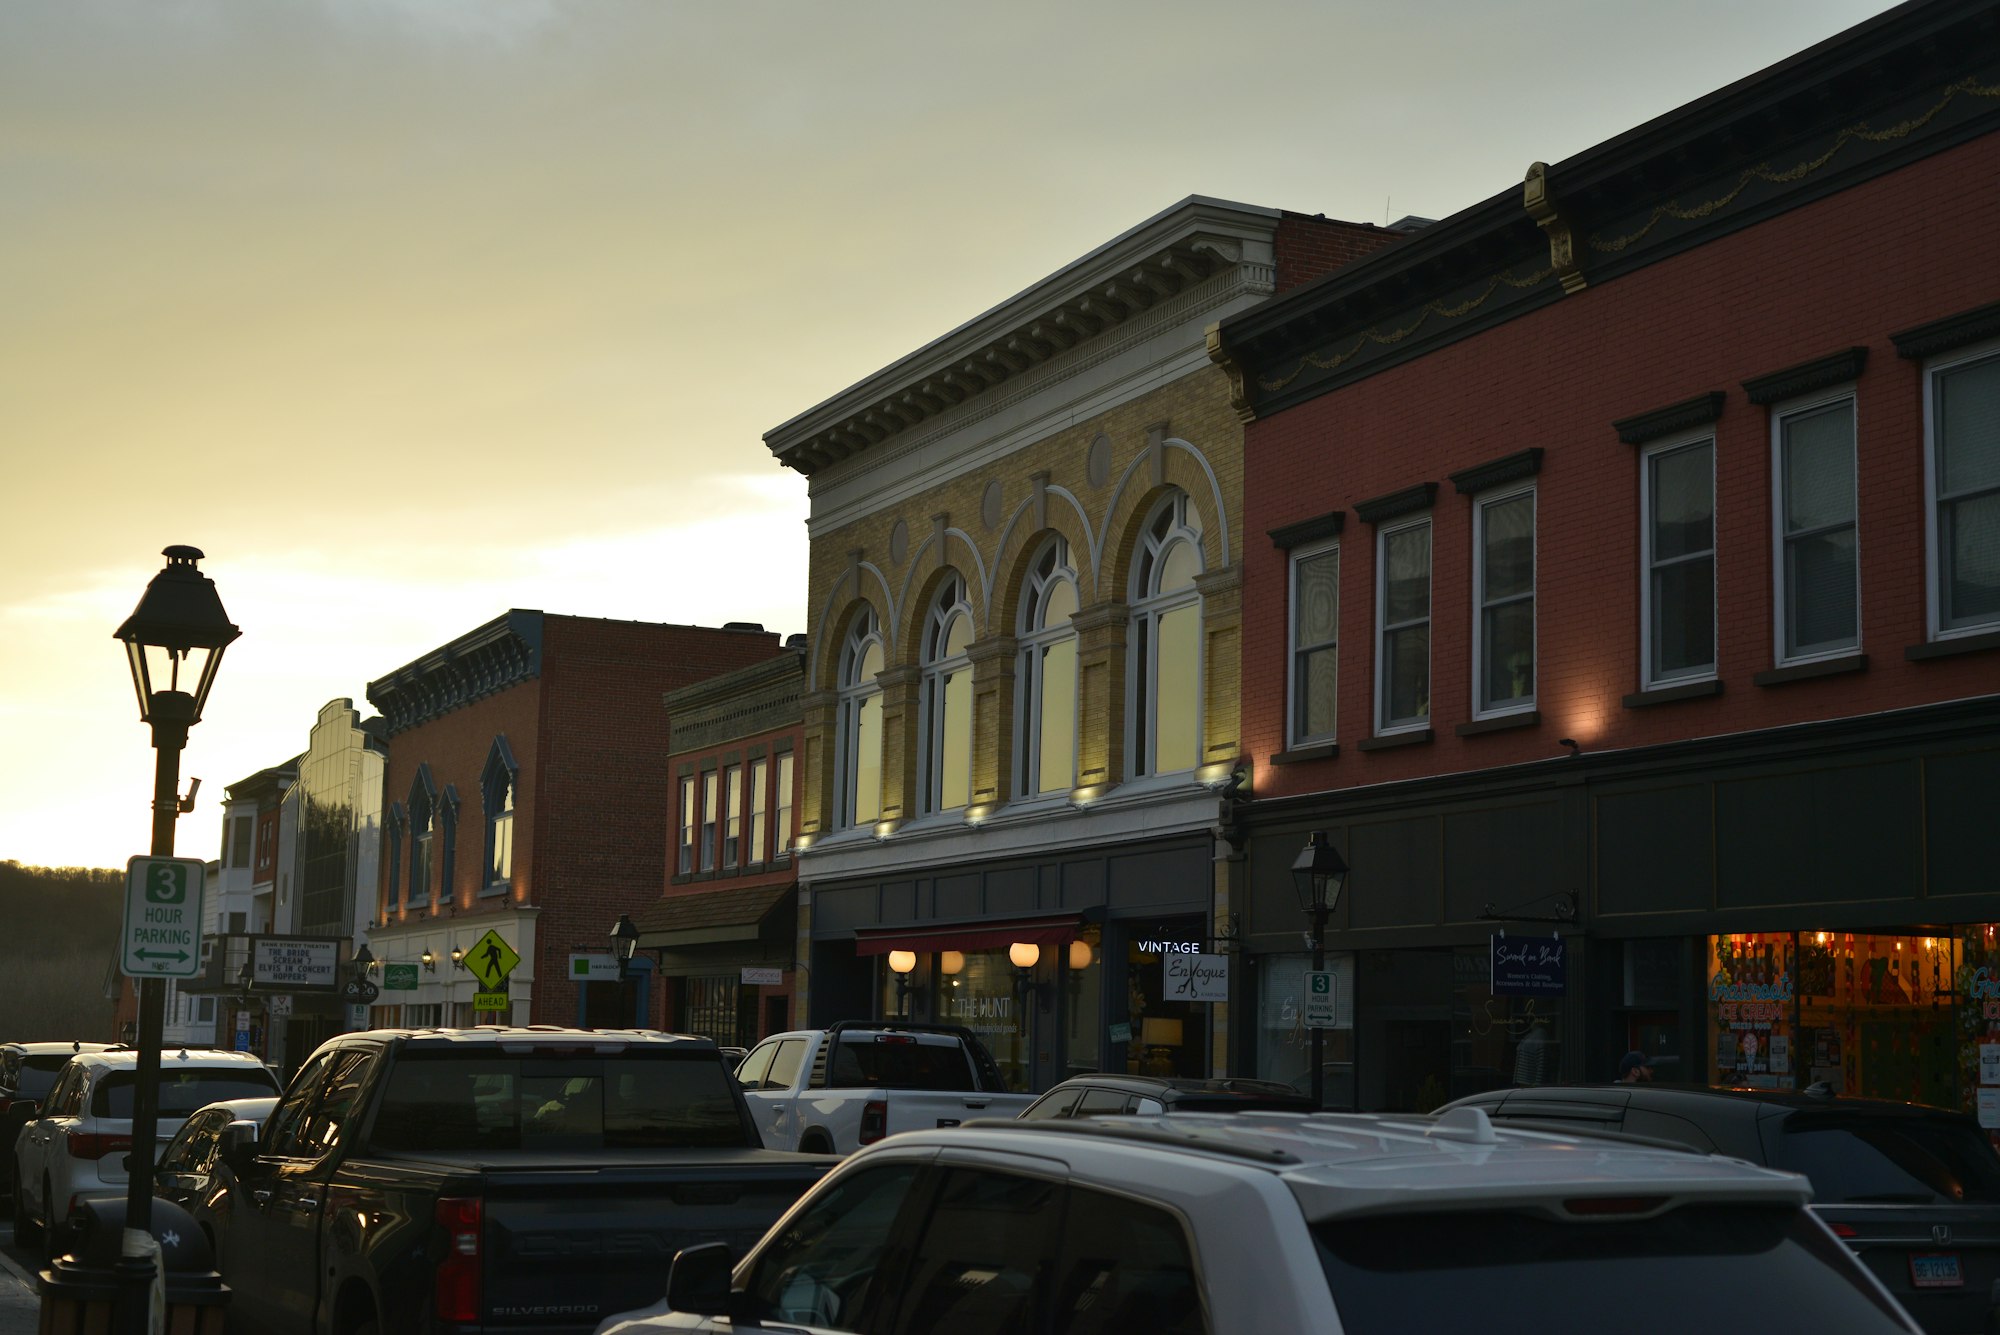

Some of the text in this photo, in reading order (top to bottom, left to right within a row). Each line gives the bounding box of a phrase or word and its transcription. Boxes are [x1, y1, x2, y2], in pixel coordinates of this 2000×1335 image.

[155, 868, 176, 900] 3
[145, 907, 183, 924] HOUR
[134, 927, 191, 945] PARKING
[268, 948, 310, 957] THE BRIDE
[1138, 940, 1200, 954] VINTAGE
[272, 956, 312, 965] SCREAM 7
[258, 963, 331, 974] ELVIS IN CONCERT
[272, 972, 307, 981] HOPPERS
[1315, 976, 1326, 992] 3
[1708, 971, 1793, 1001] Grassroots
[477, 995, 504, 1006] AHEAD
[1311, 995, 1329, 1003] HOUR
[958, 996, 1011, 1018] THE HUNT
[1307, 1004, 1333, 1013] PARKING
[1718, 1003, 1784, 1020] ICE CREAM
[492, 1304, 599, 1316] SILVERADO
